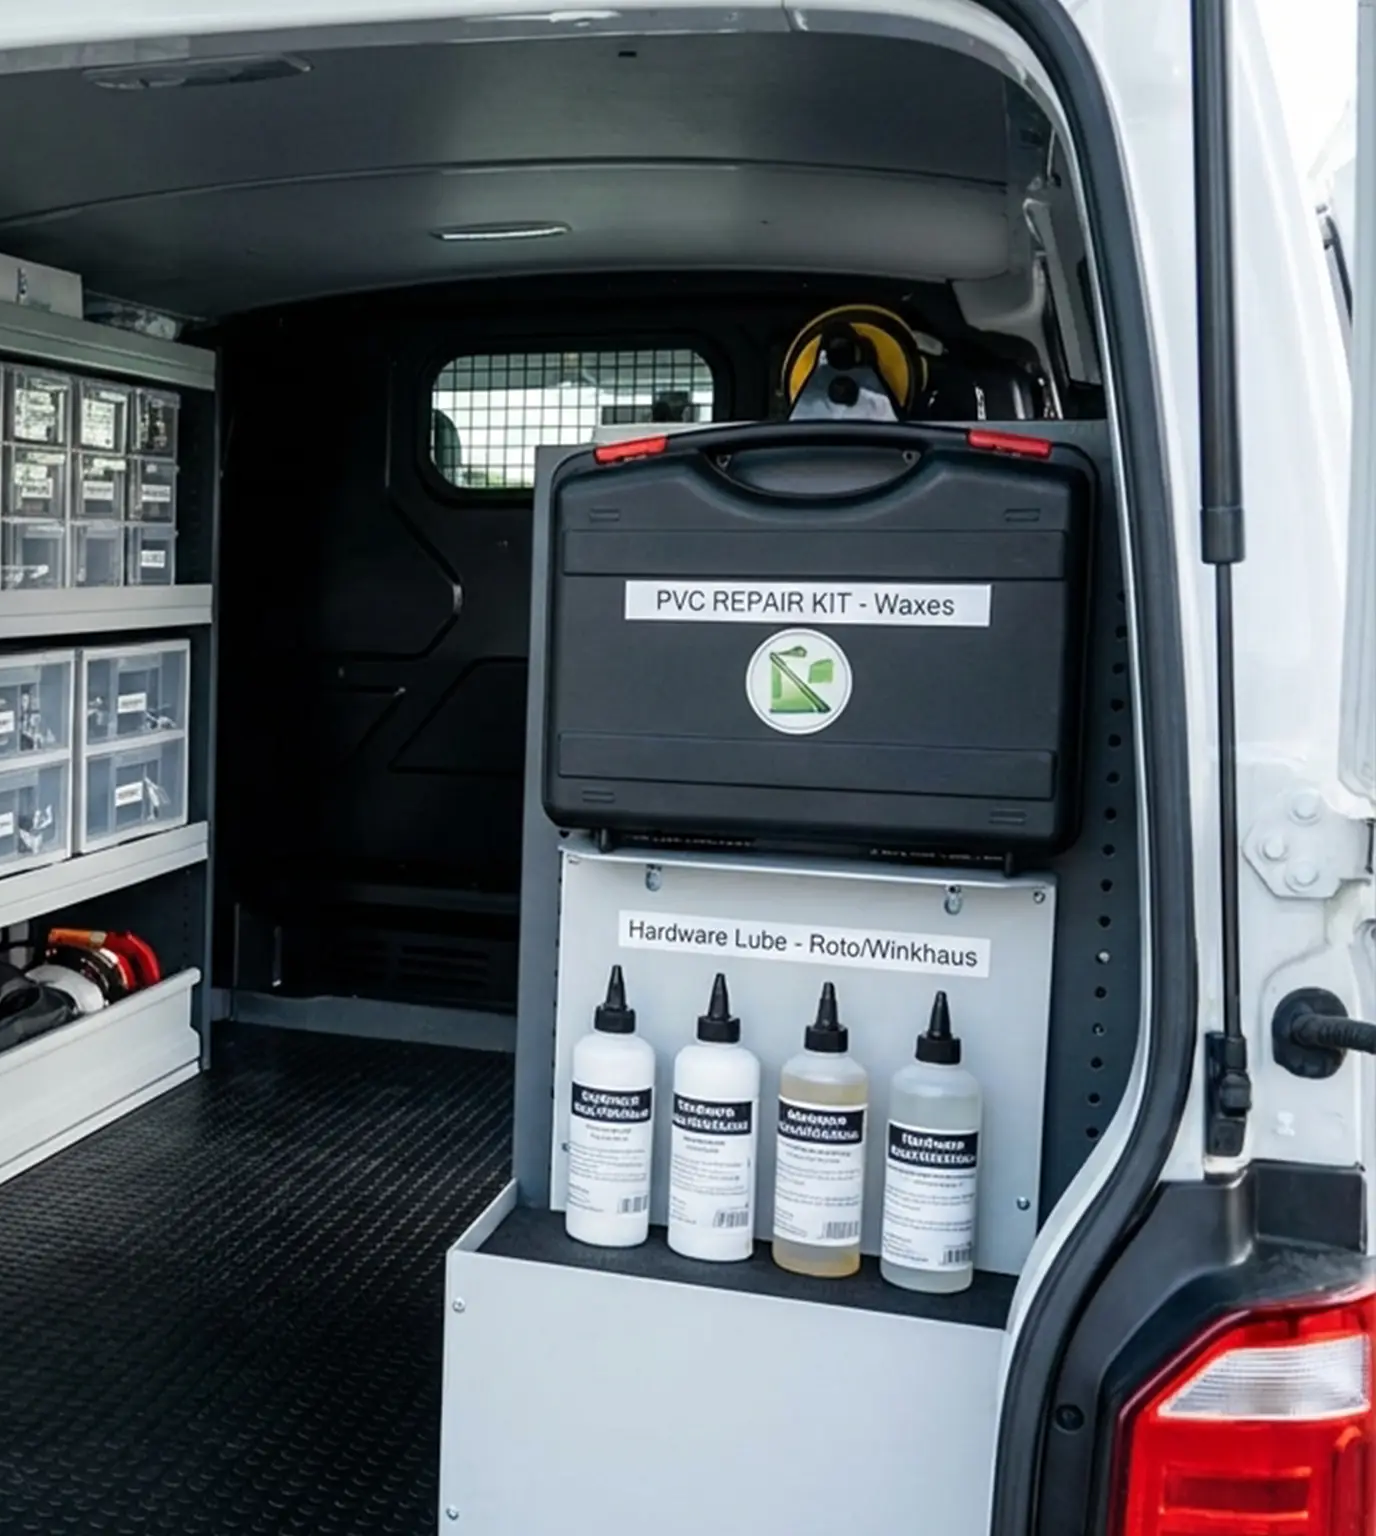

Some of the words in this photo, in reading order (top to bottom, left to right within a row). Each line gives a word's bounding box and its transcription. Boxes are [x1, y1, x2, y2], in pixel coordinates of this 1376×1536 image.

[657, 590, 705, 612] PVC
[713, 590, 804, 613] REPAIR
[812, 592, 852, 614] KIT
[874, 592, 955, 617] Waxes
[629, 920, 728, 947] Hardware
[735, 928, 788, 952] Lube
[809, 933, 978, 968] Roto/Winkhaus
